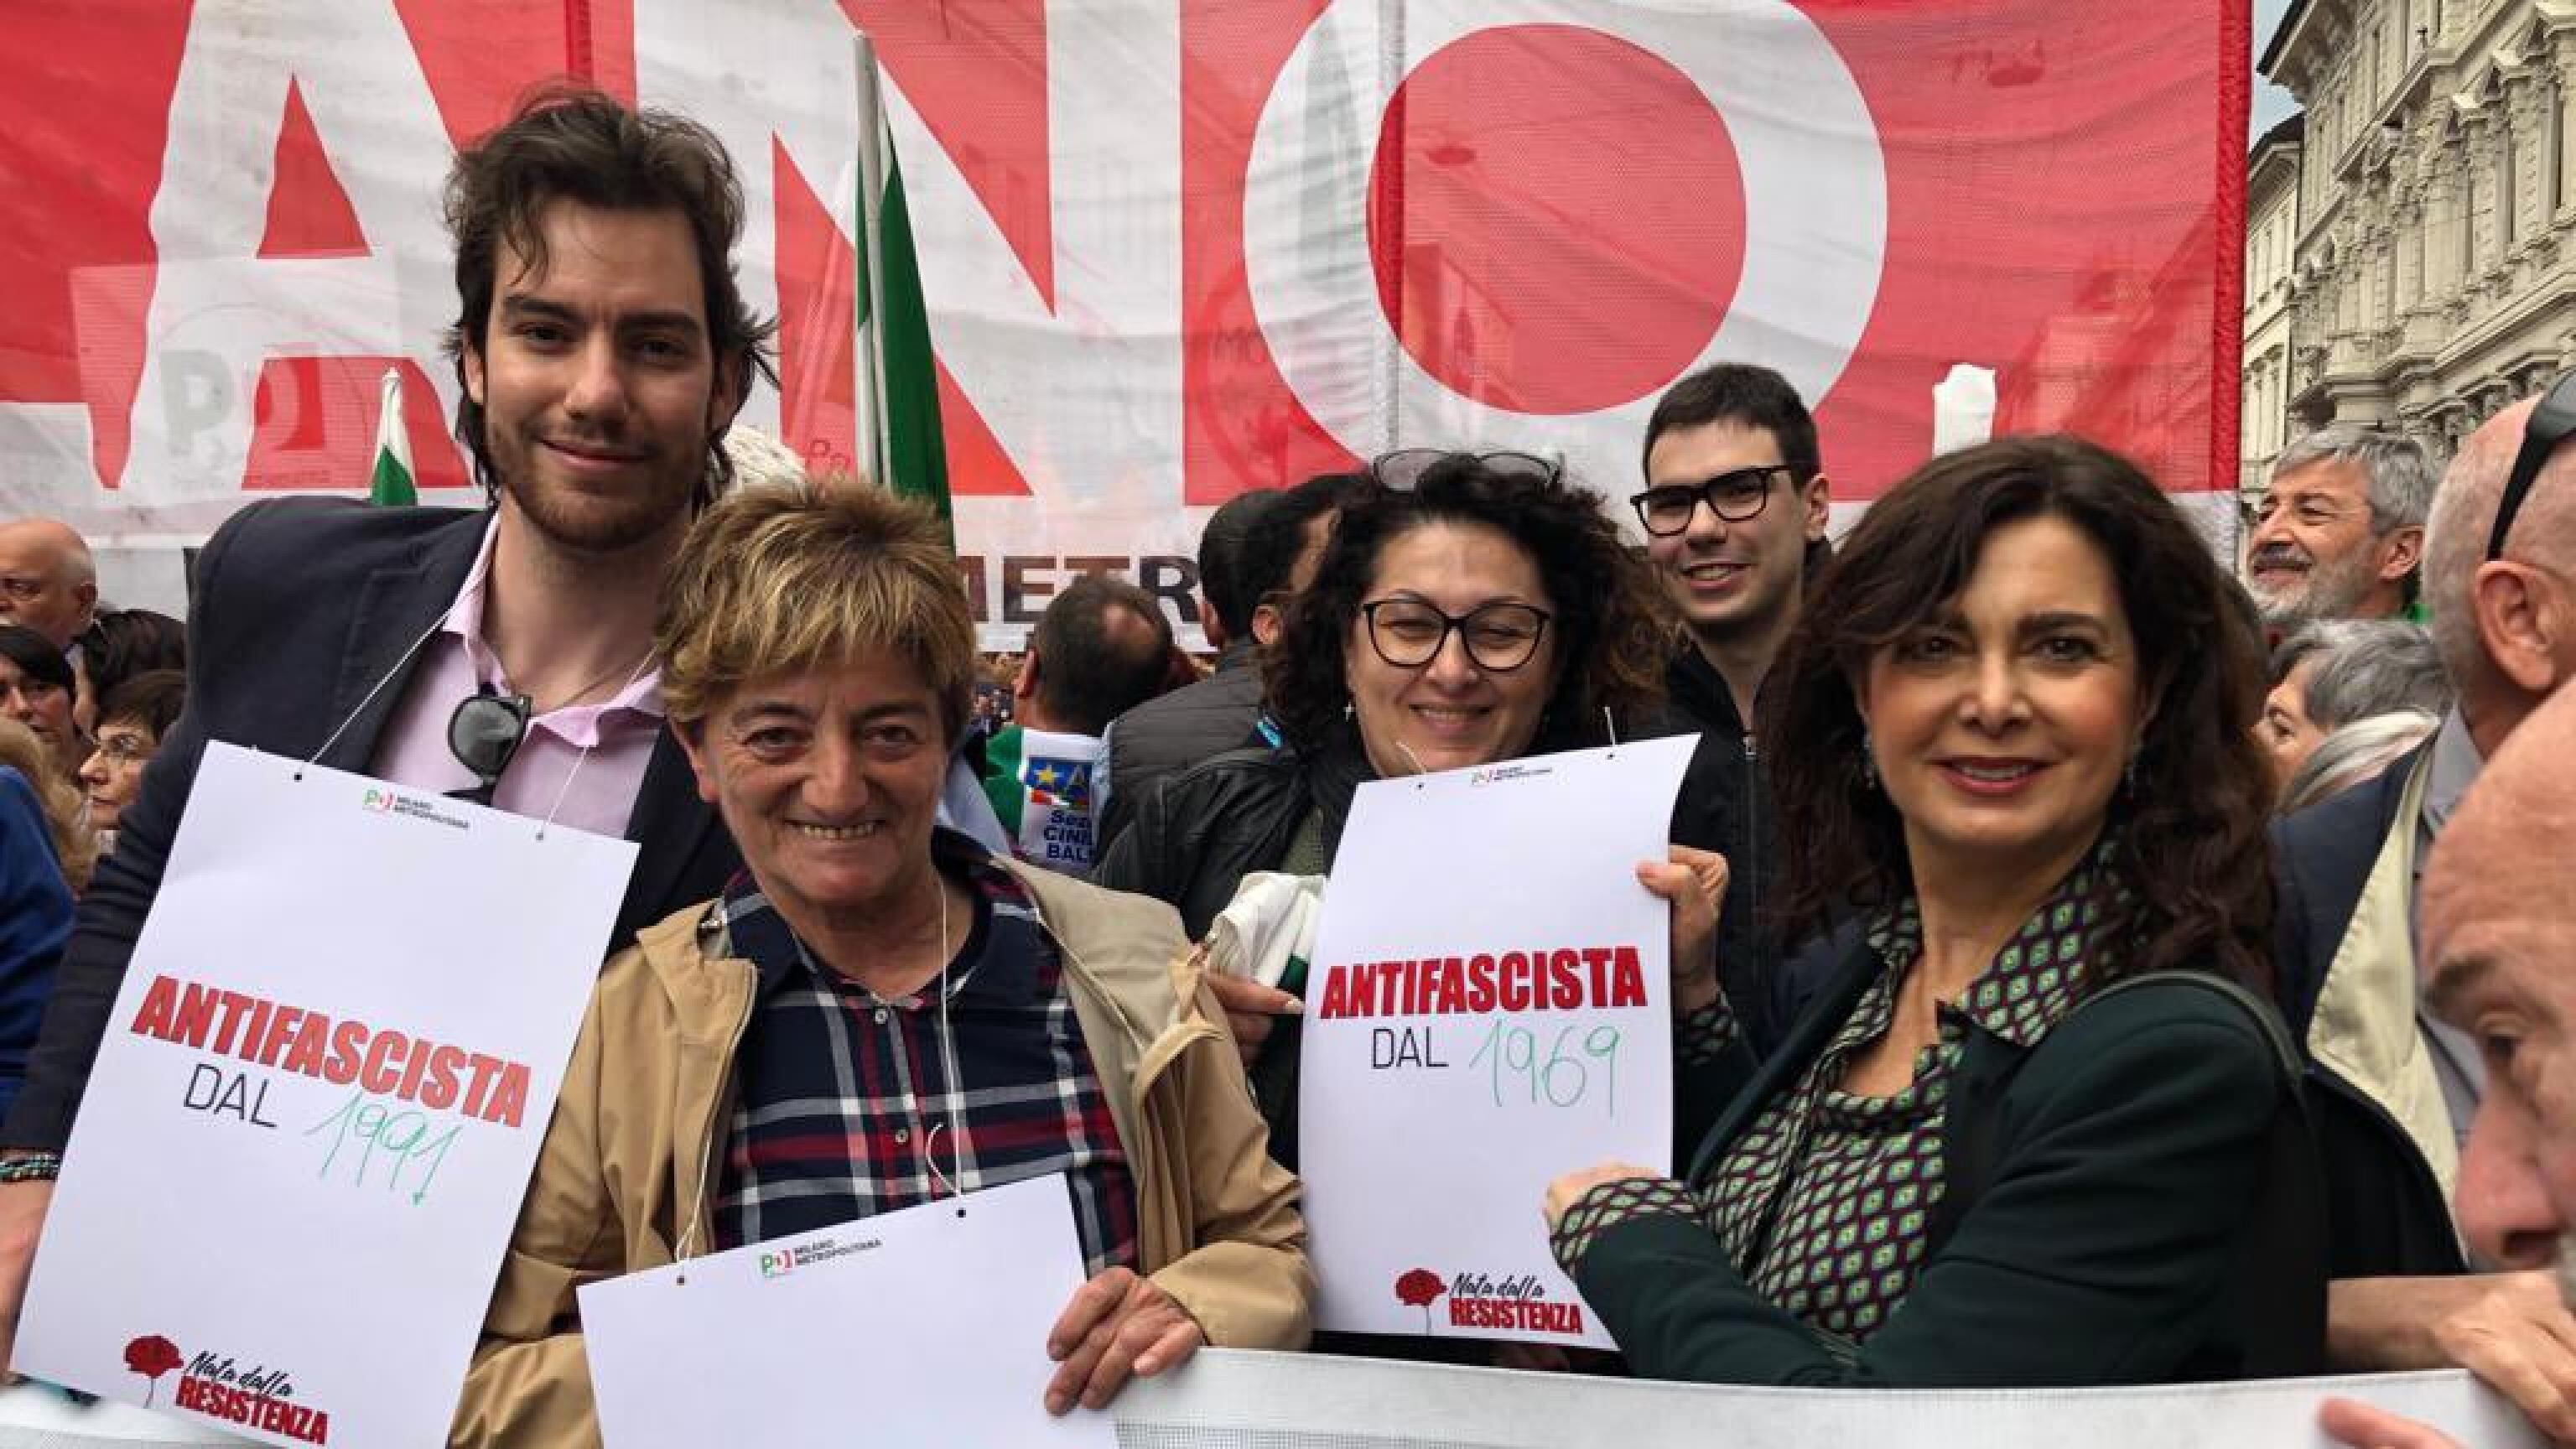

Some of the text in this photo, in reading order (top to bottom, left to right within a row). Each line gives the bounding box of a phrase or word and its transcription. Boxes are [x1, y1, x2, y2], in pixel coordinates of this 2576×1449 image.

[1320, 945, 1649, 1020] ANTIFASCISTA
[130, 974, 531, 1128] ANTIFASCISTA
[1371, 1018, 1621, 1119] DAL 1969
[183, 1062, 464, 1206] DAL 1991
[1450, 1297, 1583, 1334] RESISTENZA
[175, 1375, 329, 1447] RESISTENZA
